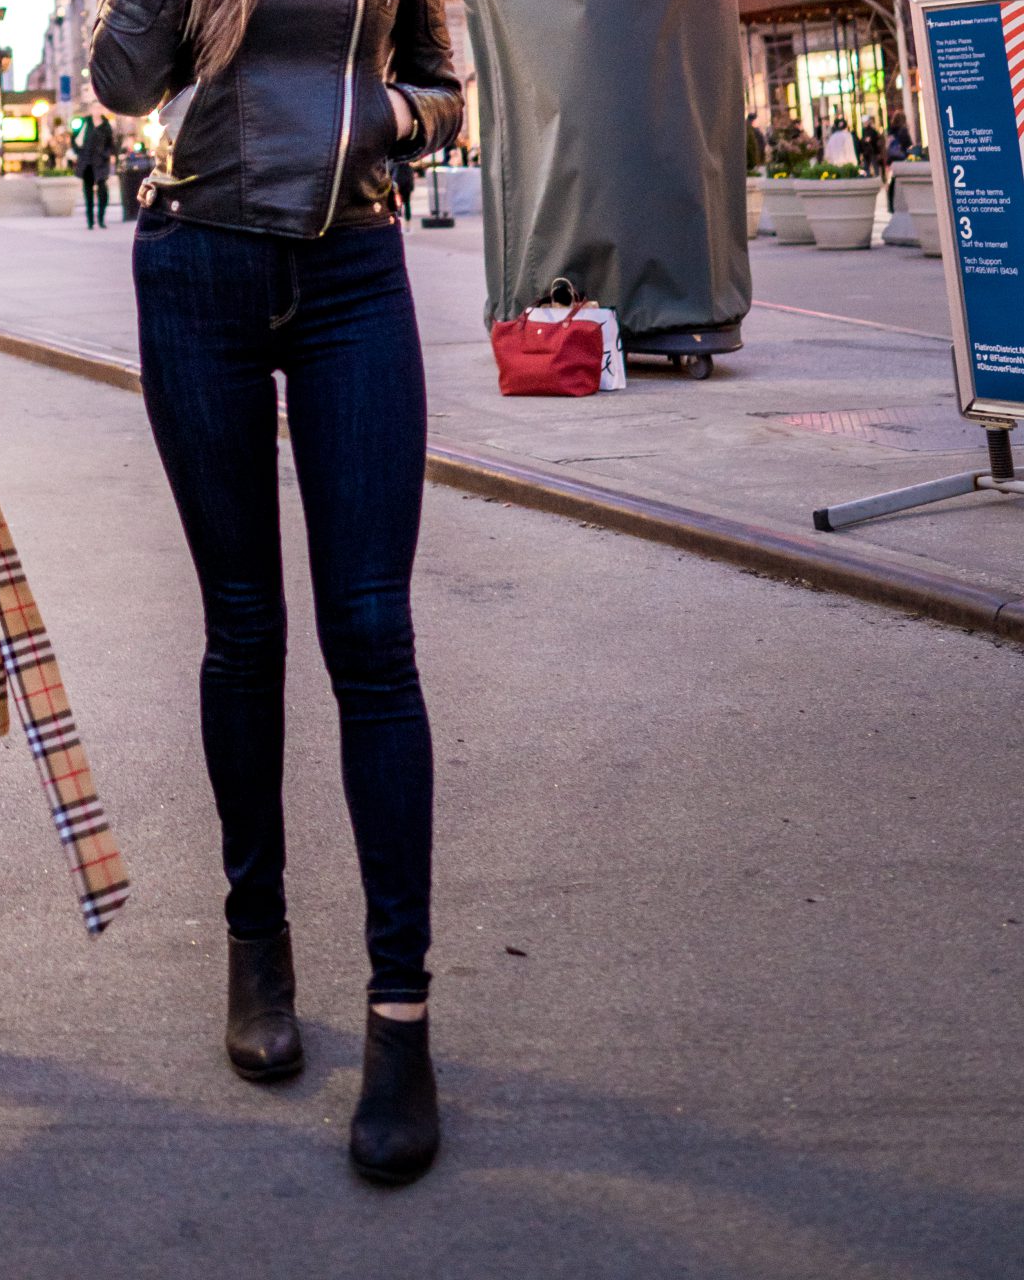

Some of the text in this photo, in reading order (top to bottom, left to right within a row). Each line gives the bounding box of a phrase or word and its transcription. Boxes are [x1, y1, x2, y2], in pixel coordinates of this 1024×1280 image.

[946, 105, 954, 128] 1
[963, 146, 976, 154] your
[977, 144, 1001, 152] wireless
[952, 165, 966, 188] 2
[959, 216, 972, 240] 3
[974, 240, 984, 248] the
[978, 257, 1002, 266] Support
